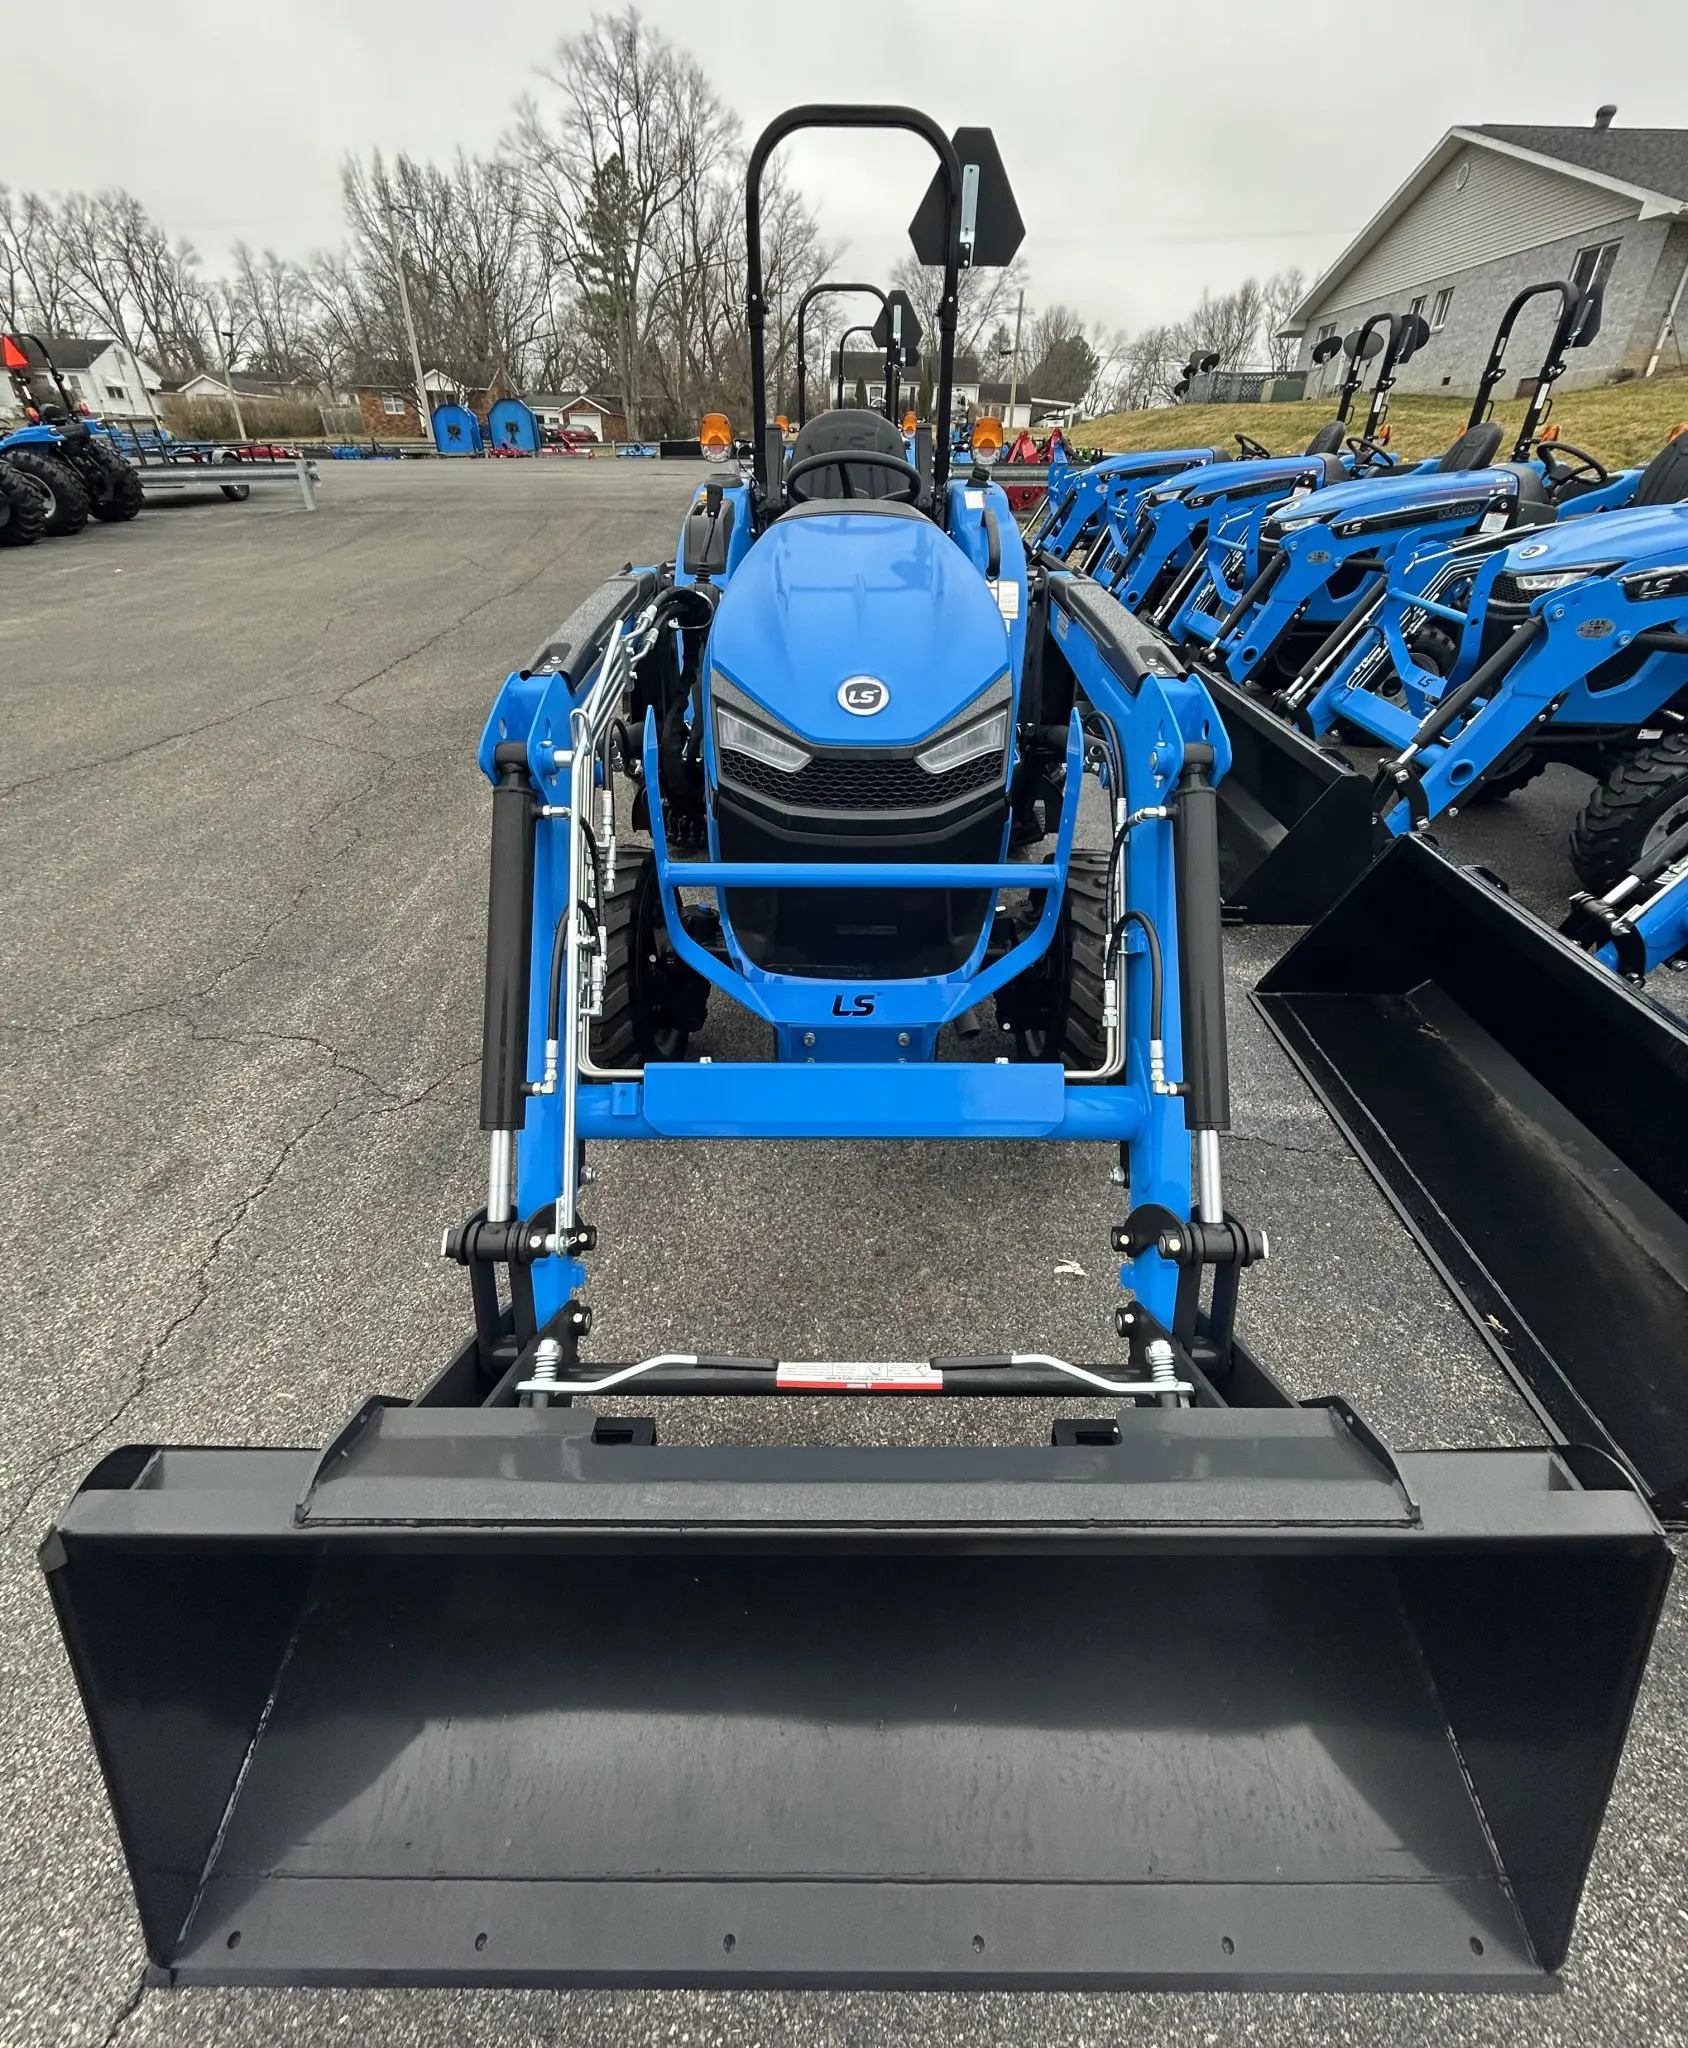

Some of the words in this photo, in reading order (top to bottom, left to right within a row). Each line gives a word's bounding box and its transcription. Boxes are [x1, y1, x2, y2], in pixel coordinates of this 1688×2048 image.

[1191, 496, 1205, 507] LS
[1342, 522, 1363, 535] LS
[1638, 577, 1675, 599] LS
[1417, 676, 1436, 688] LS
[848, 689, 879, 704] LS
[832, 993, 879, 1017] LS
